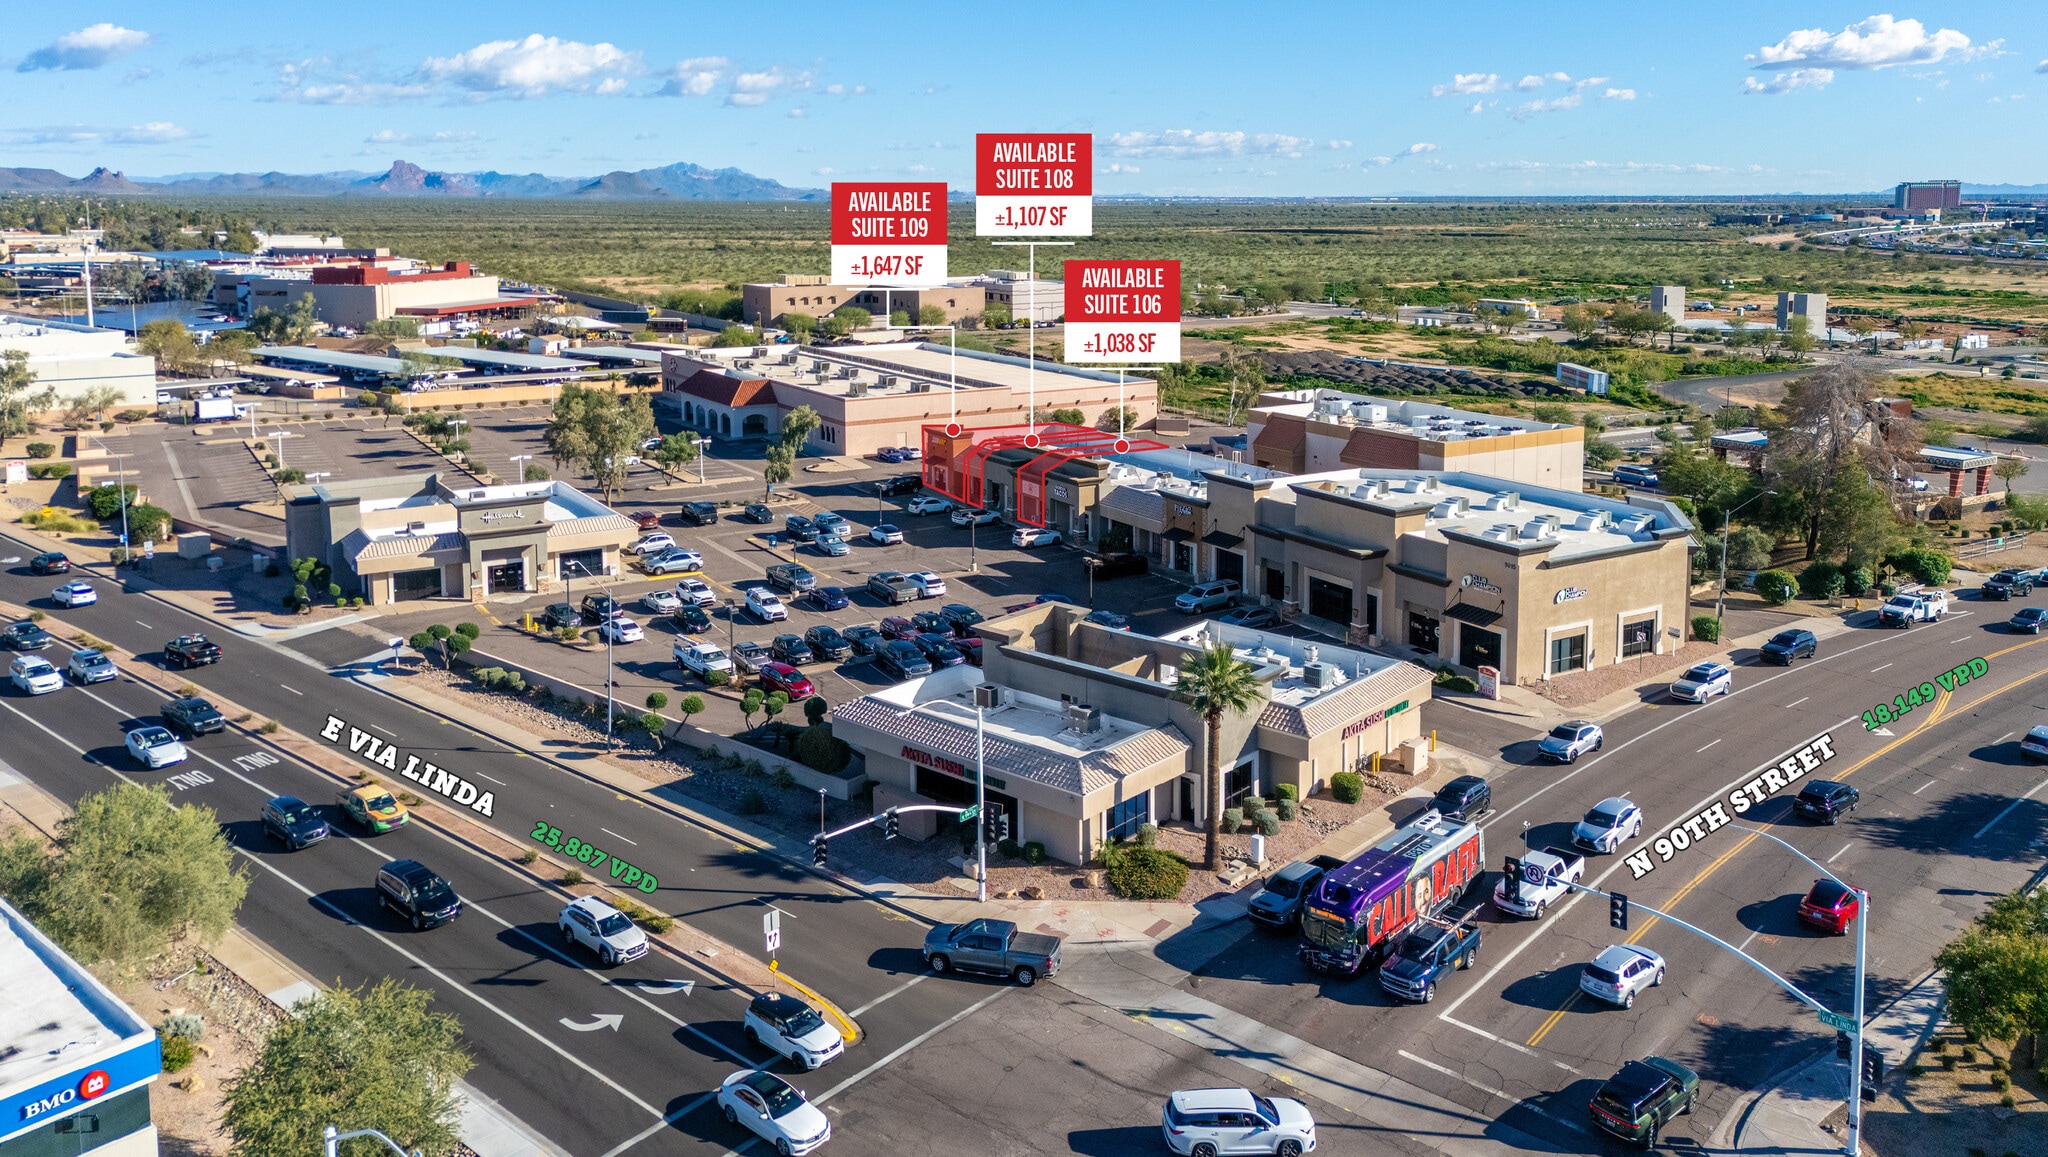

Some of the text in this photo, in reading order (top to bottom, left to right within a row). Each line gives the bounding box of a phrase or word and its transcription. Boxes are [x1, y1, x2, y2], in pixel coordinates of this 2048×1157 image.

[480, 509, 525, 524] Hallmark
[1472, 582, 1501, 593] CHAMPION
[231, 751, 279, 771] ONLY
[901, 746, 965, 778] AKITA SUSHI
[166, 770, 214, 791] ONLY
[1367, 880, 1418, 948] CALL
[1821, 1015, 1833, 1025] VIA
[1835, 1019, 1857, 1032] LINDA
[25, 1088, 76, 1119] BMO
